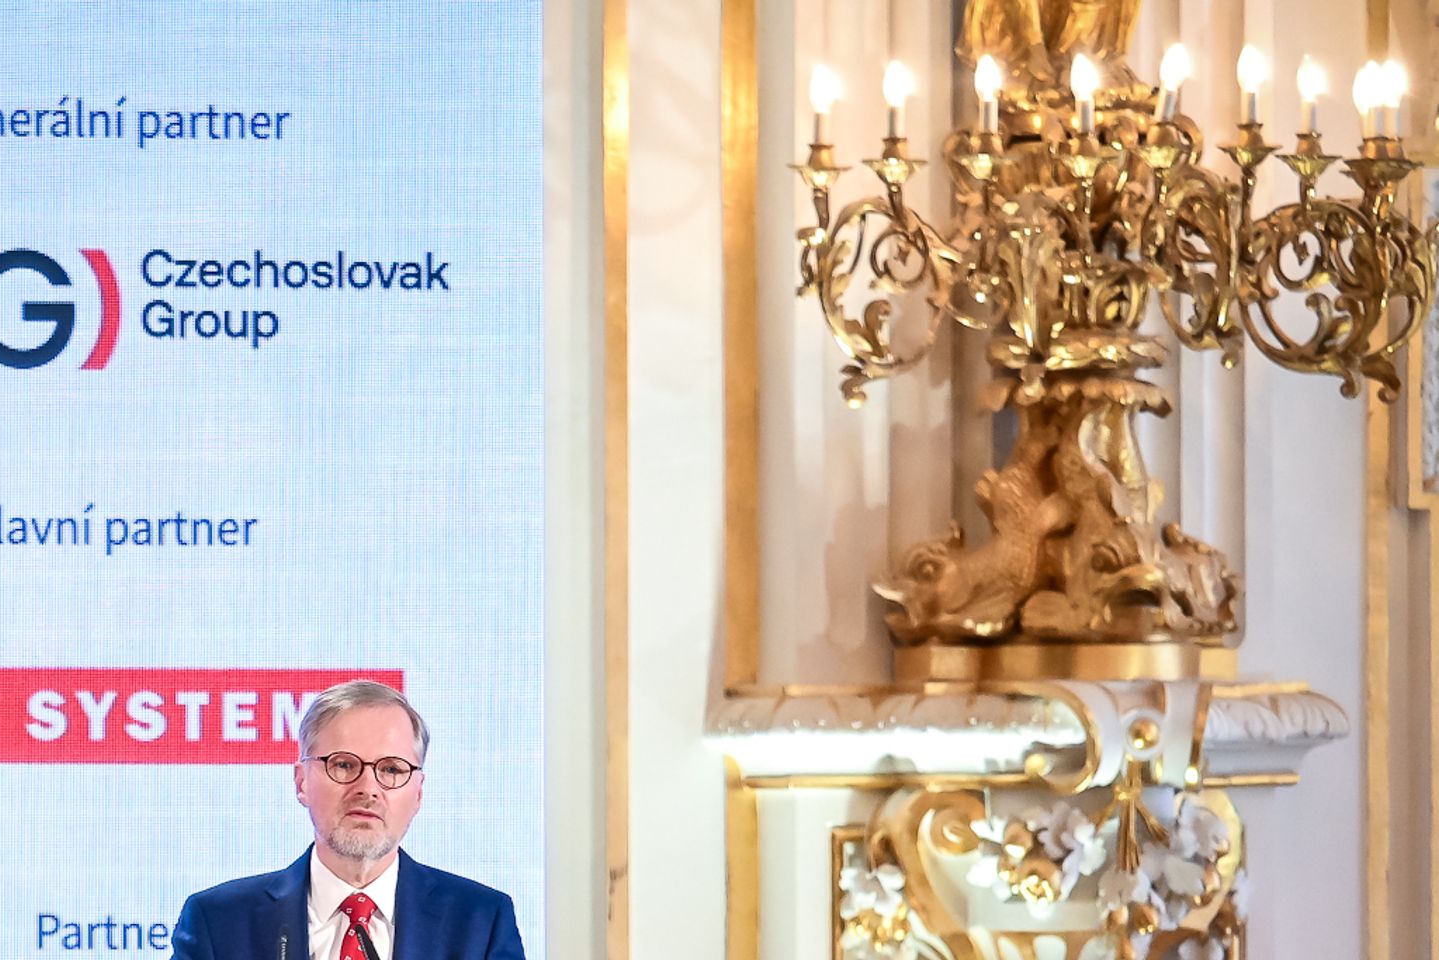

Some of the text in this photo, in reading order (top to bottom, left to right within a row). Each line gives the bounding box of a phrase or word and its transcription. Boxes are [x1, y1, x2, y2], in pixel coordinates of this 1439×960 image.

[138, 104, 291, 149] partner
[141, 249, 450, 291] Czechoslovak
[141, 299, 280, 349] Group
[105, 512, 258, 556] partner
[25, 690, 321, 742] SYSTEM
[37, 913, 170, 951] Partne
